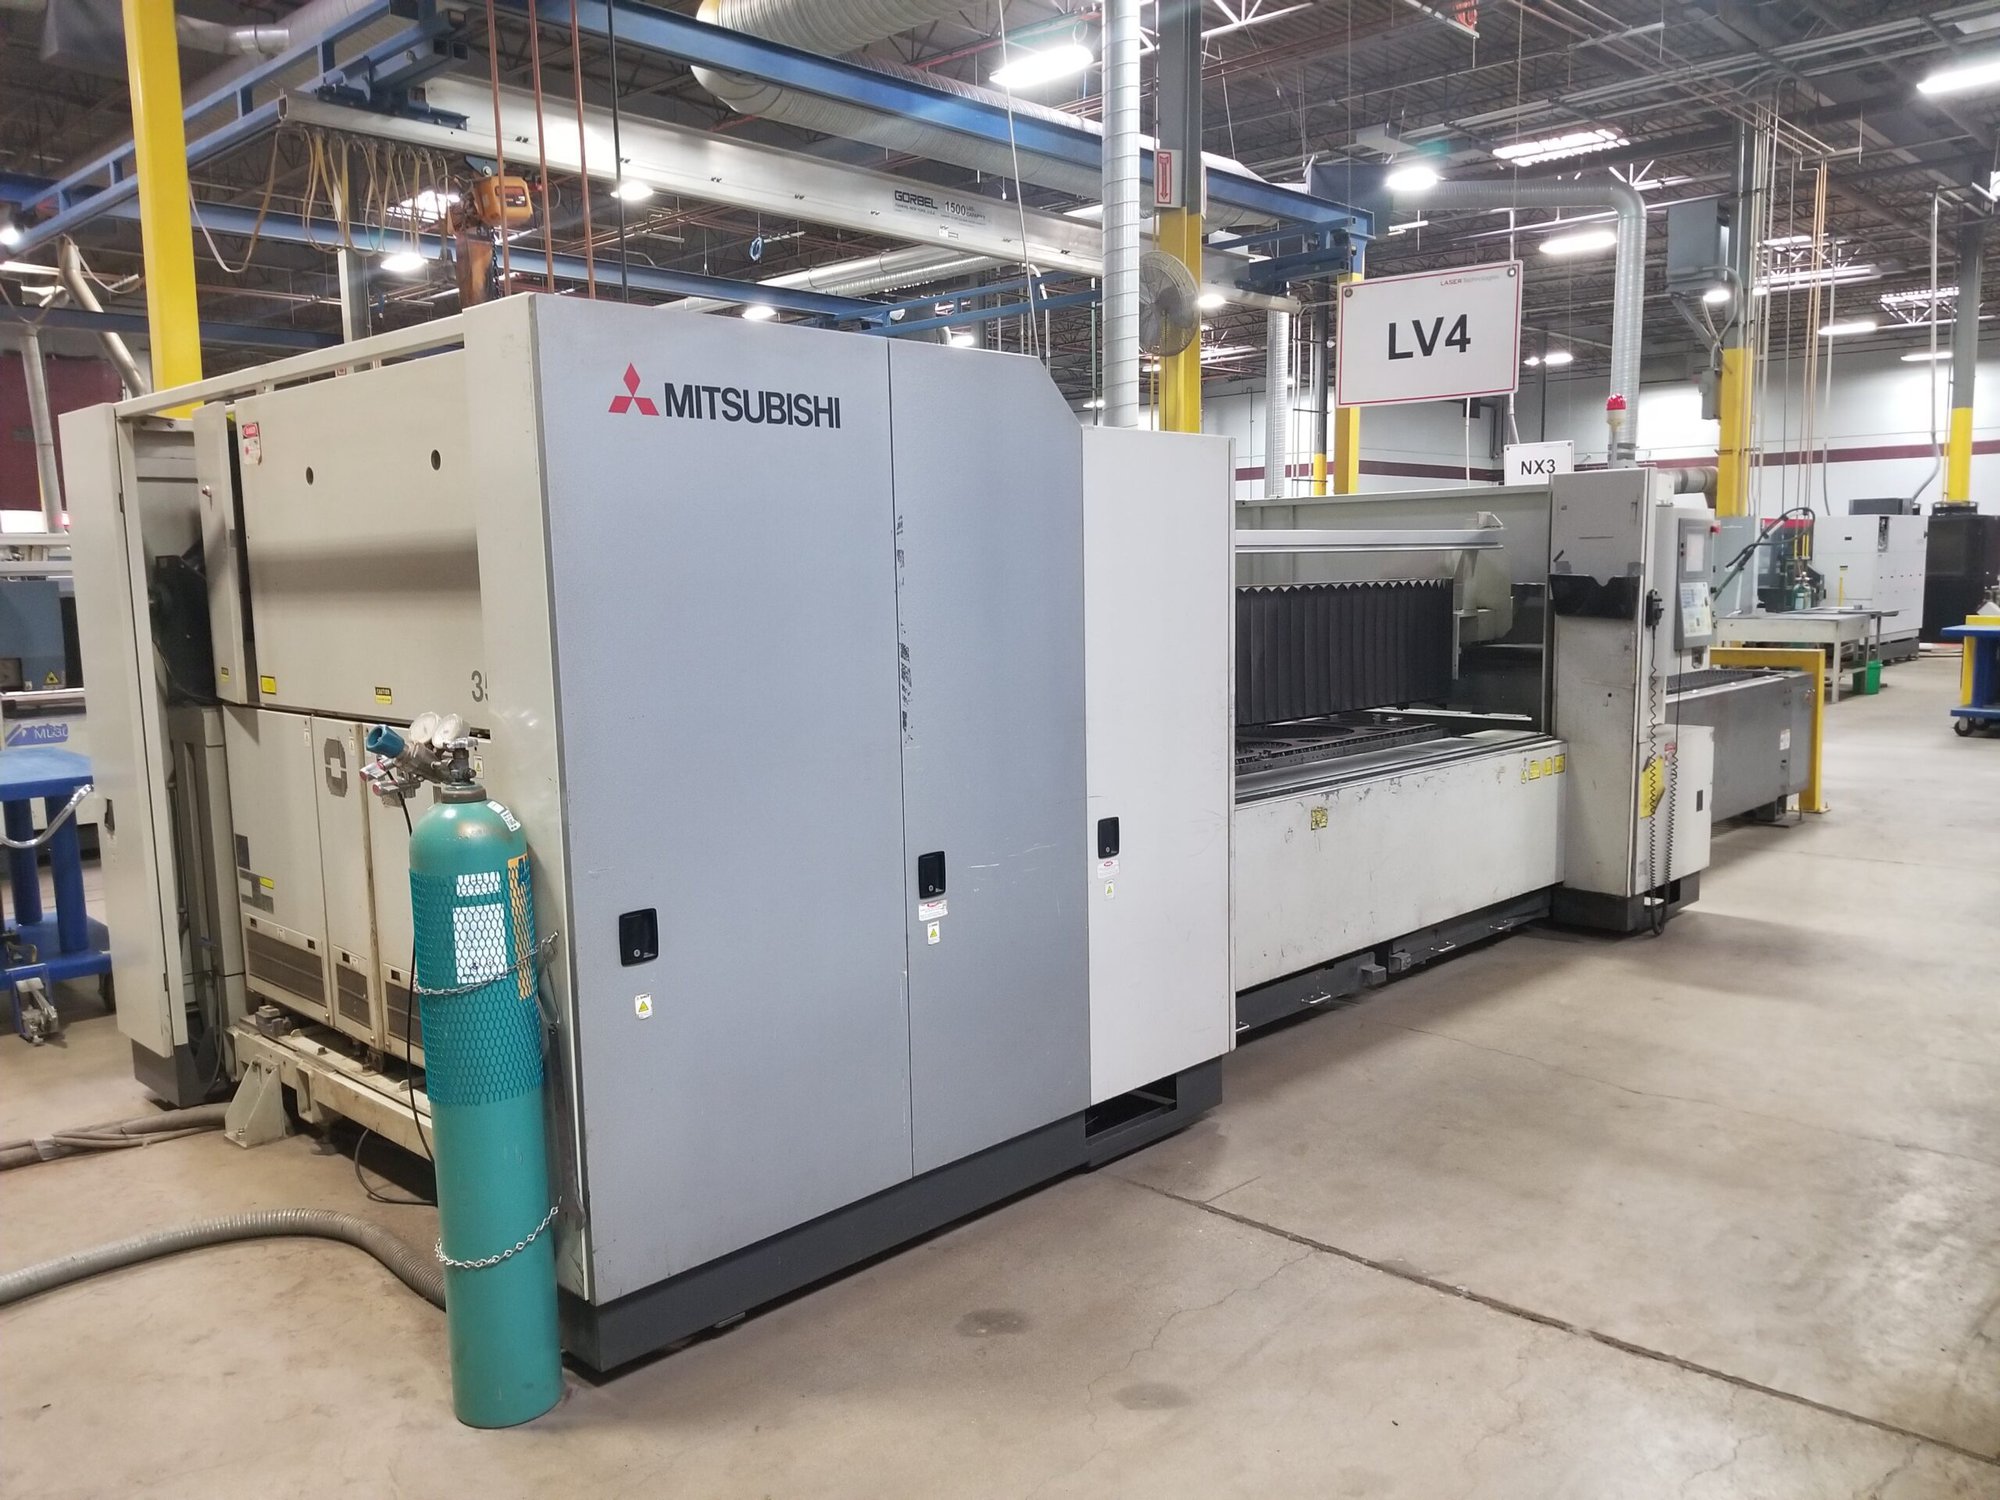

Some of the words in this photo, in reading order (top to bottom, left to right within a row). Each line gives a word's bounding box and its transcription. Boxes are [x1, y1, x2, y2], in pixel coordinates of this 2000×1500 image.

[894, 190, 938, 210] GORBEL
[945, 201, 966, 216] 1500
[1440, 278, 1462, 286] LASER
[1388, 314, 1471, 360] LV4
[664, 382, 841, 429] MITSUBISHI
[1521, 459, 1556, 475] NX3
[471, 670, 488, 702] 3
